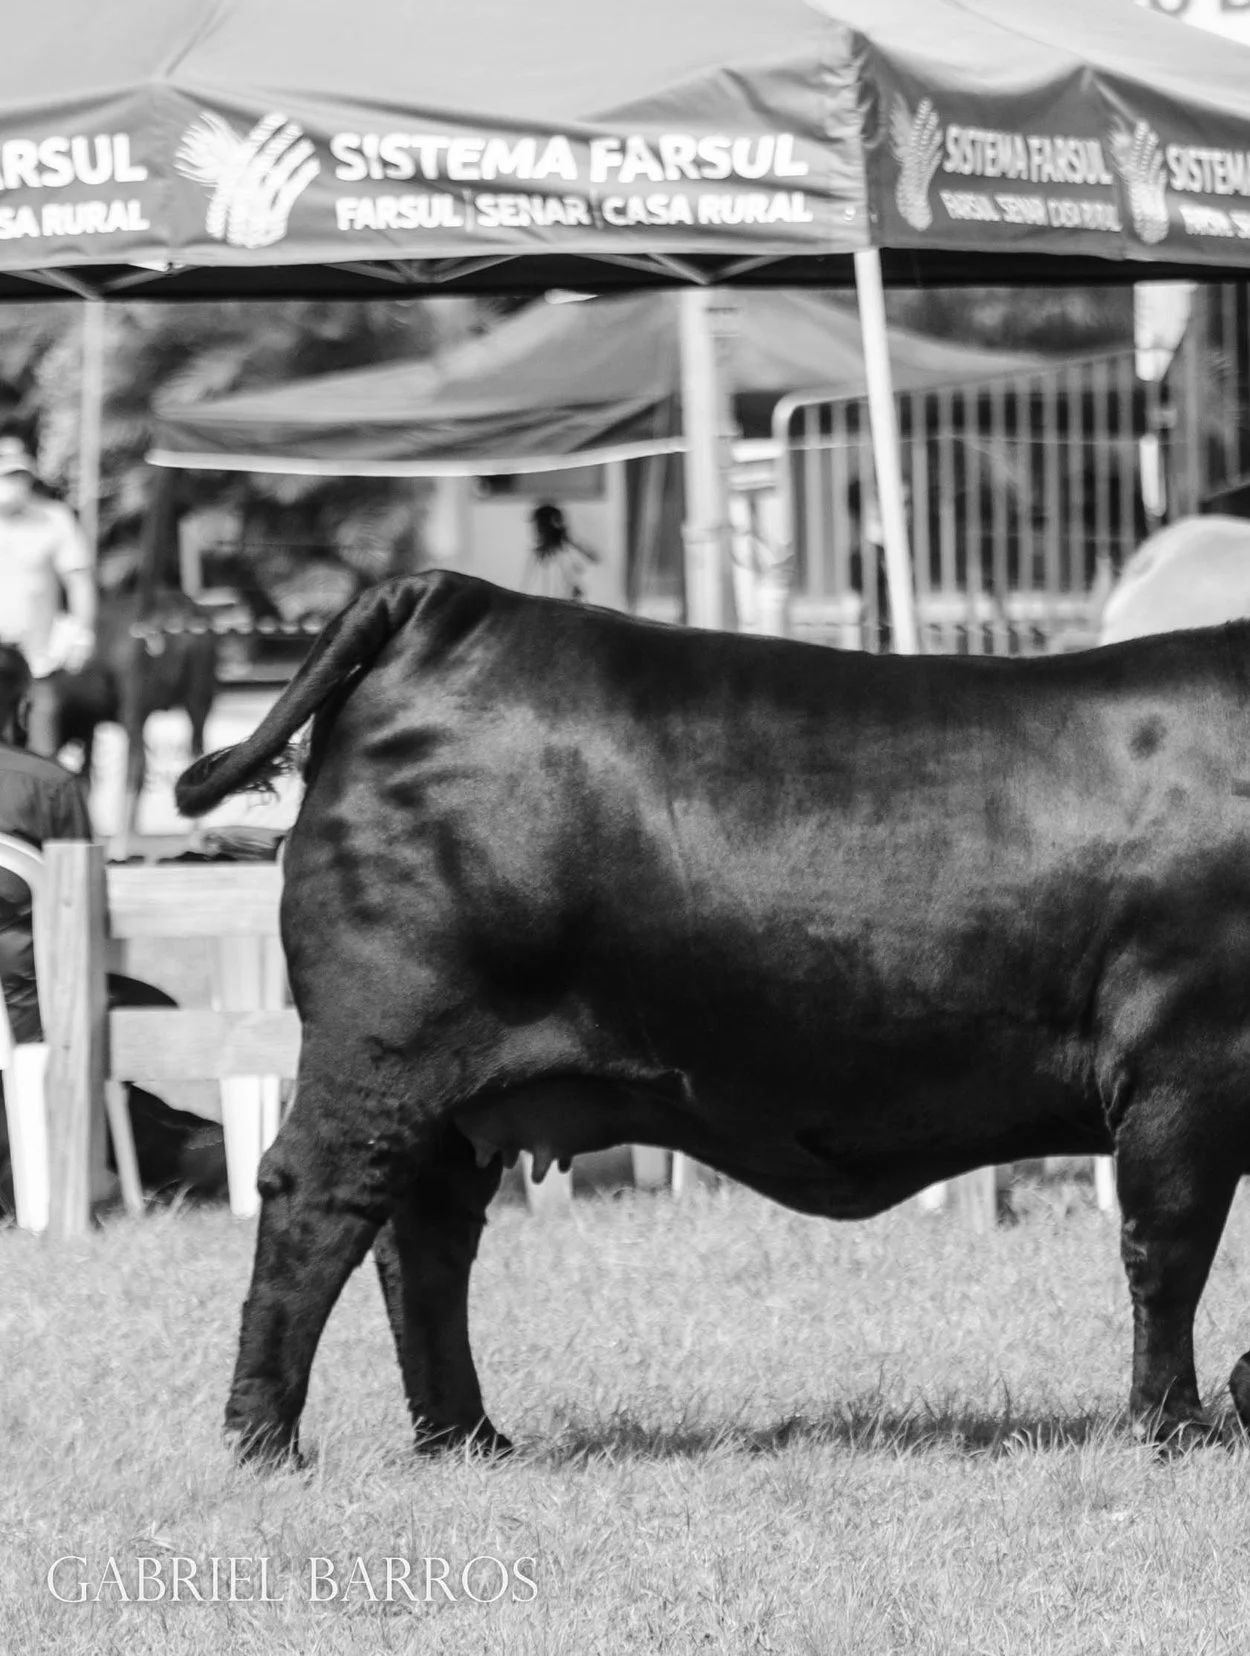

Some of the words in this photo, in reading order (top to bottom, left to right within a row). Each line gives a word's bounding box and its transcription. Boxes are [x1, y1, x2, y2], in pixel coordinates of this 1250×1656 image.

[0, 132, 149, 190] RSUL
[330, 132, 578, 181] SISTEMA
[590, 133, 809, 183] FARSUL
[942, 124, 1029, 180] SISTEMA
[1026, 135, 1113, 185] FARSUL
[42, 199, 150, 236] RURAL
[335, 194, 464, 230] FARSUL
[475, 193, 593, 227] SENAR
[602, 193, 694, 226] CASA
[697, 191, 813, 224] RURAL
